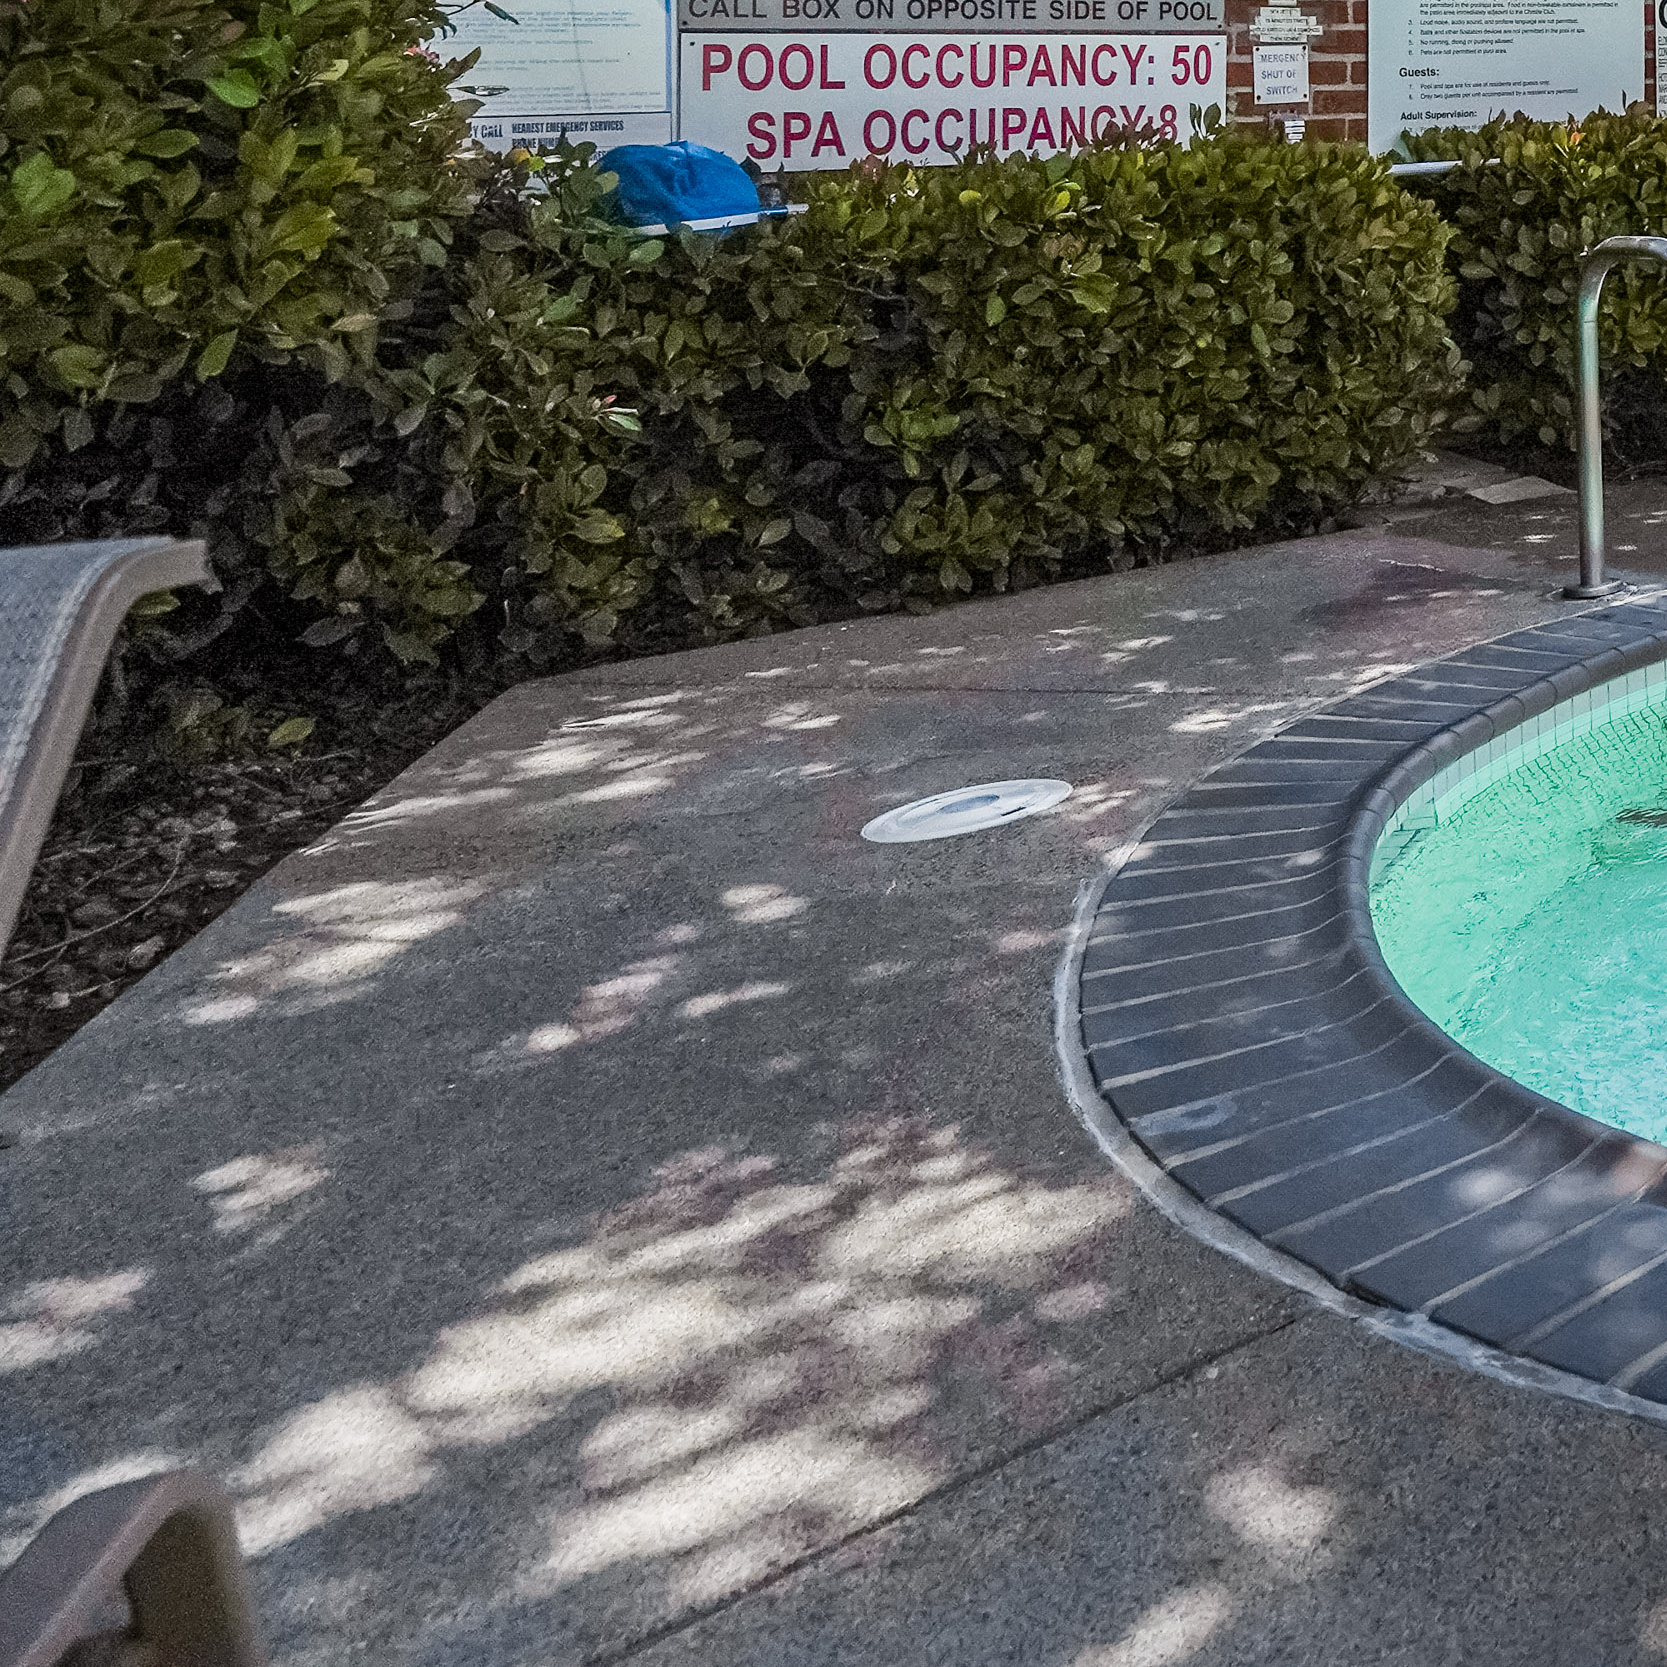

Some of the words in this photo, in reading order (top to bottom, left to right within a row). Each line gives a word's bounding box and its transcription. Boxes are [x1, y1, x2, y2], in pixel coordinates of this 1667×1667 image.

[1050, 0, 1105, 20] SIDE
[1117, 0, 1149, 20] OF
[1159, 1, 1217, 21] POOL
[702, 43, 846, 91] POOL
[863, 43, 1155, 90] OCCUPANCY:
[1171, 44, 1212, 86] 50
[1399, 67, 1440, 77] Guests:
[1261, 70, 1284, 80] SHUT
[1266, 85, 1298, 96] SWITCH
[1400, 111, 1423, 120] Adult
[1425, 110, 1477, 121] Supervision:
[481, 124, 503, 138] CALL
[512, 122, 544, 134] NEAREST
[546, 121, 588, 133] EMERGENCY
[590, 120, 624, 131] SERVICES
[746, 111, 846, 160] SPA
